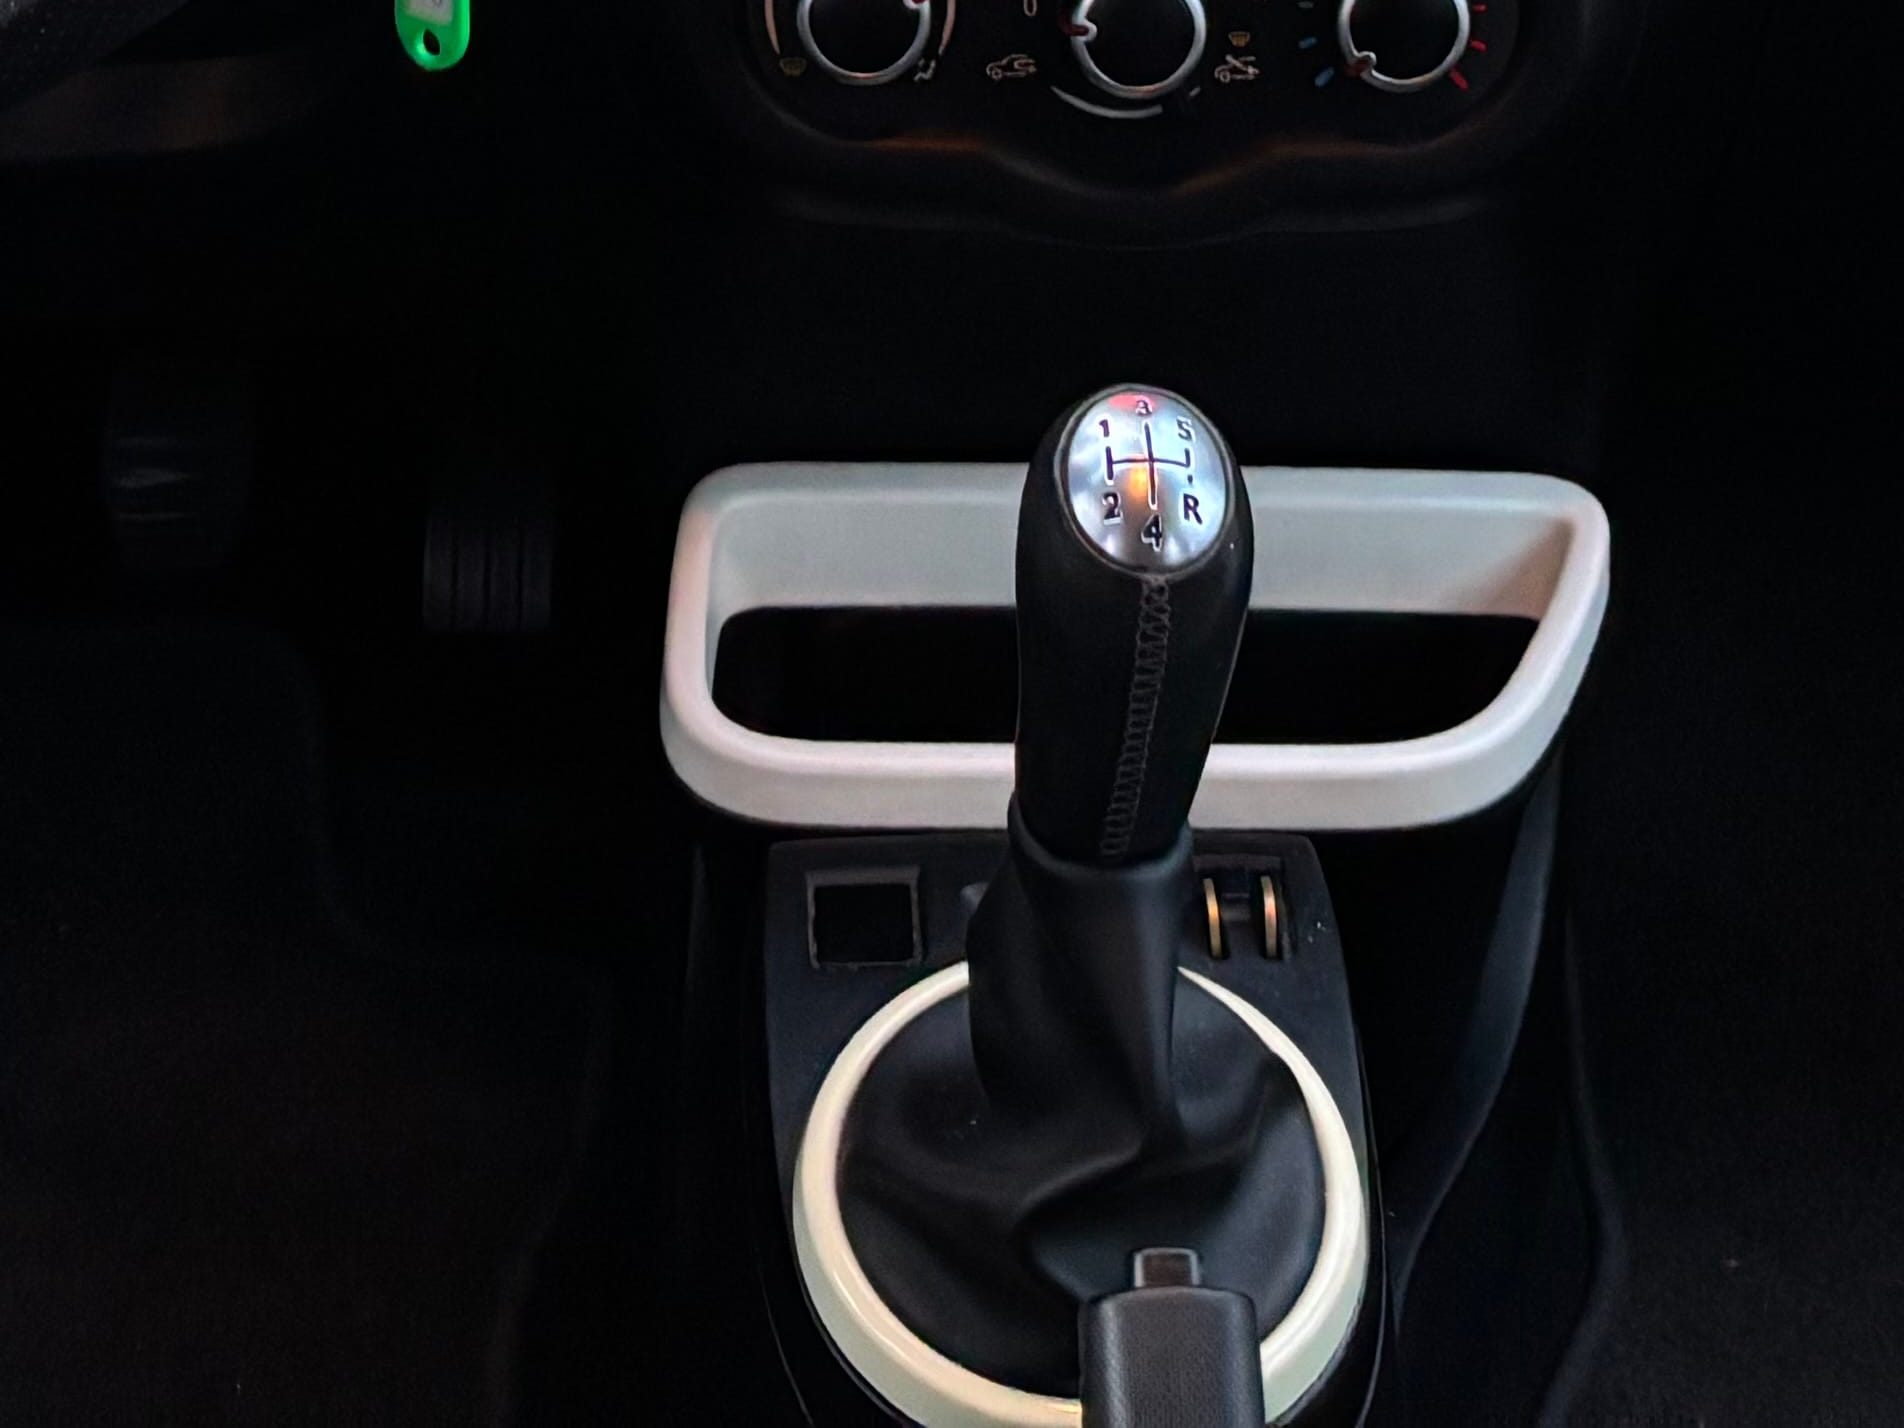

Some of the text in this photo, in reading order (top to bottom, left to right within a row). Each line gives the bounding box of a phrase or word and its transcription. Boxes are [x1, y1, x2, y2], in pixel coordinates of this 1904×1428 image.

[1099, 418, 1111, 438] 1
[1176, 418, 1193, 441] 5
[1101, 492, 1203, 551] 2 4 R
